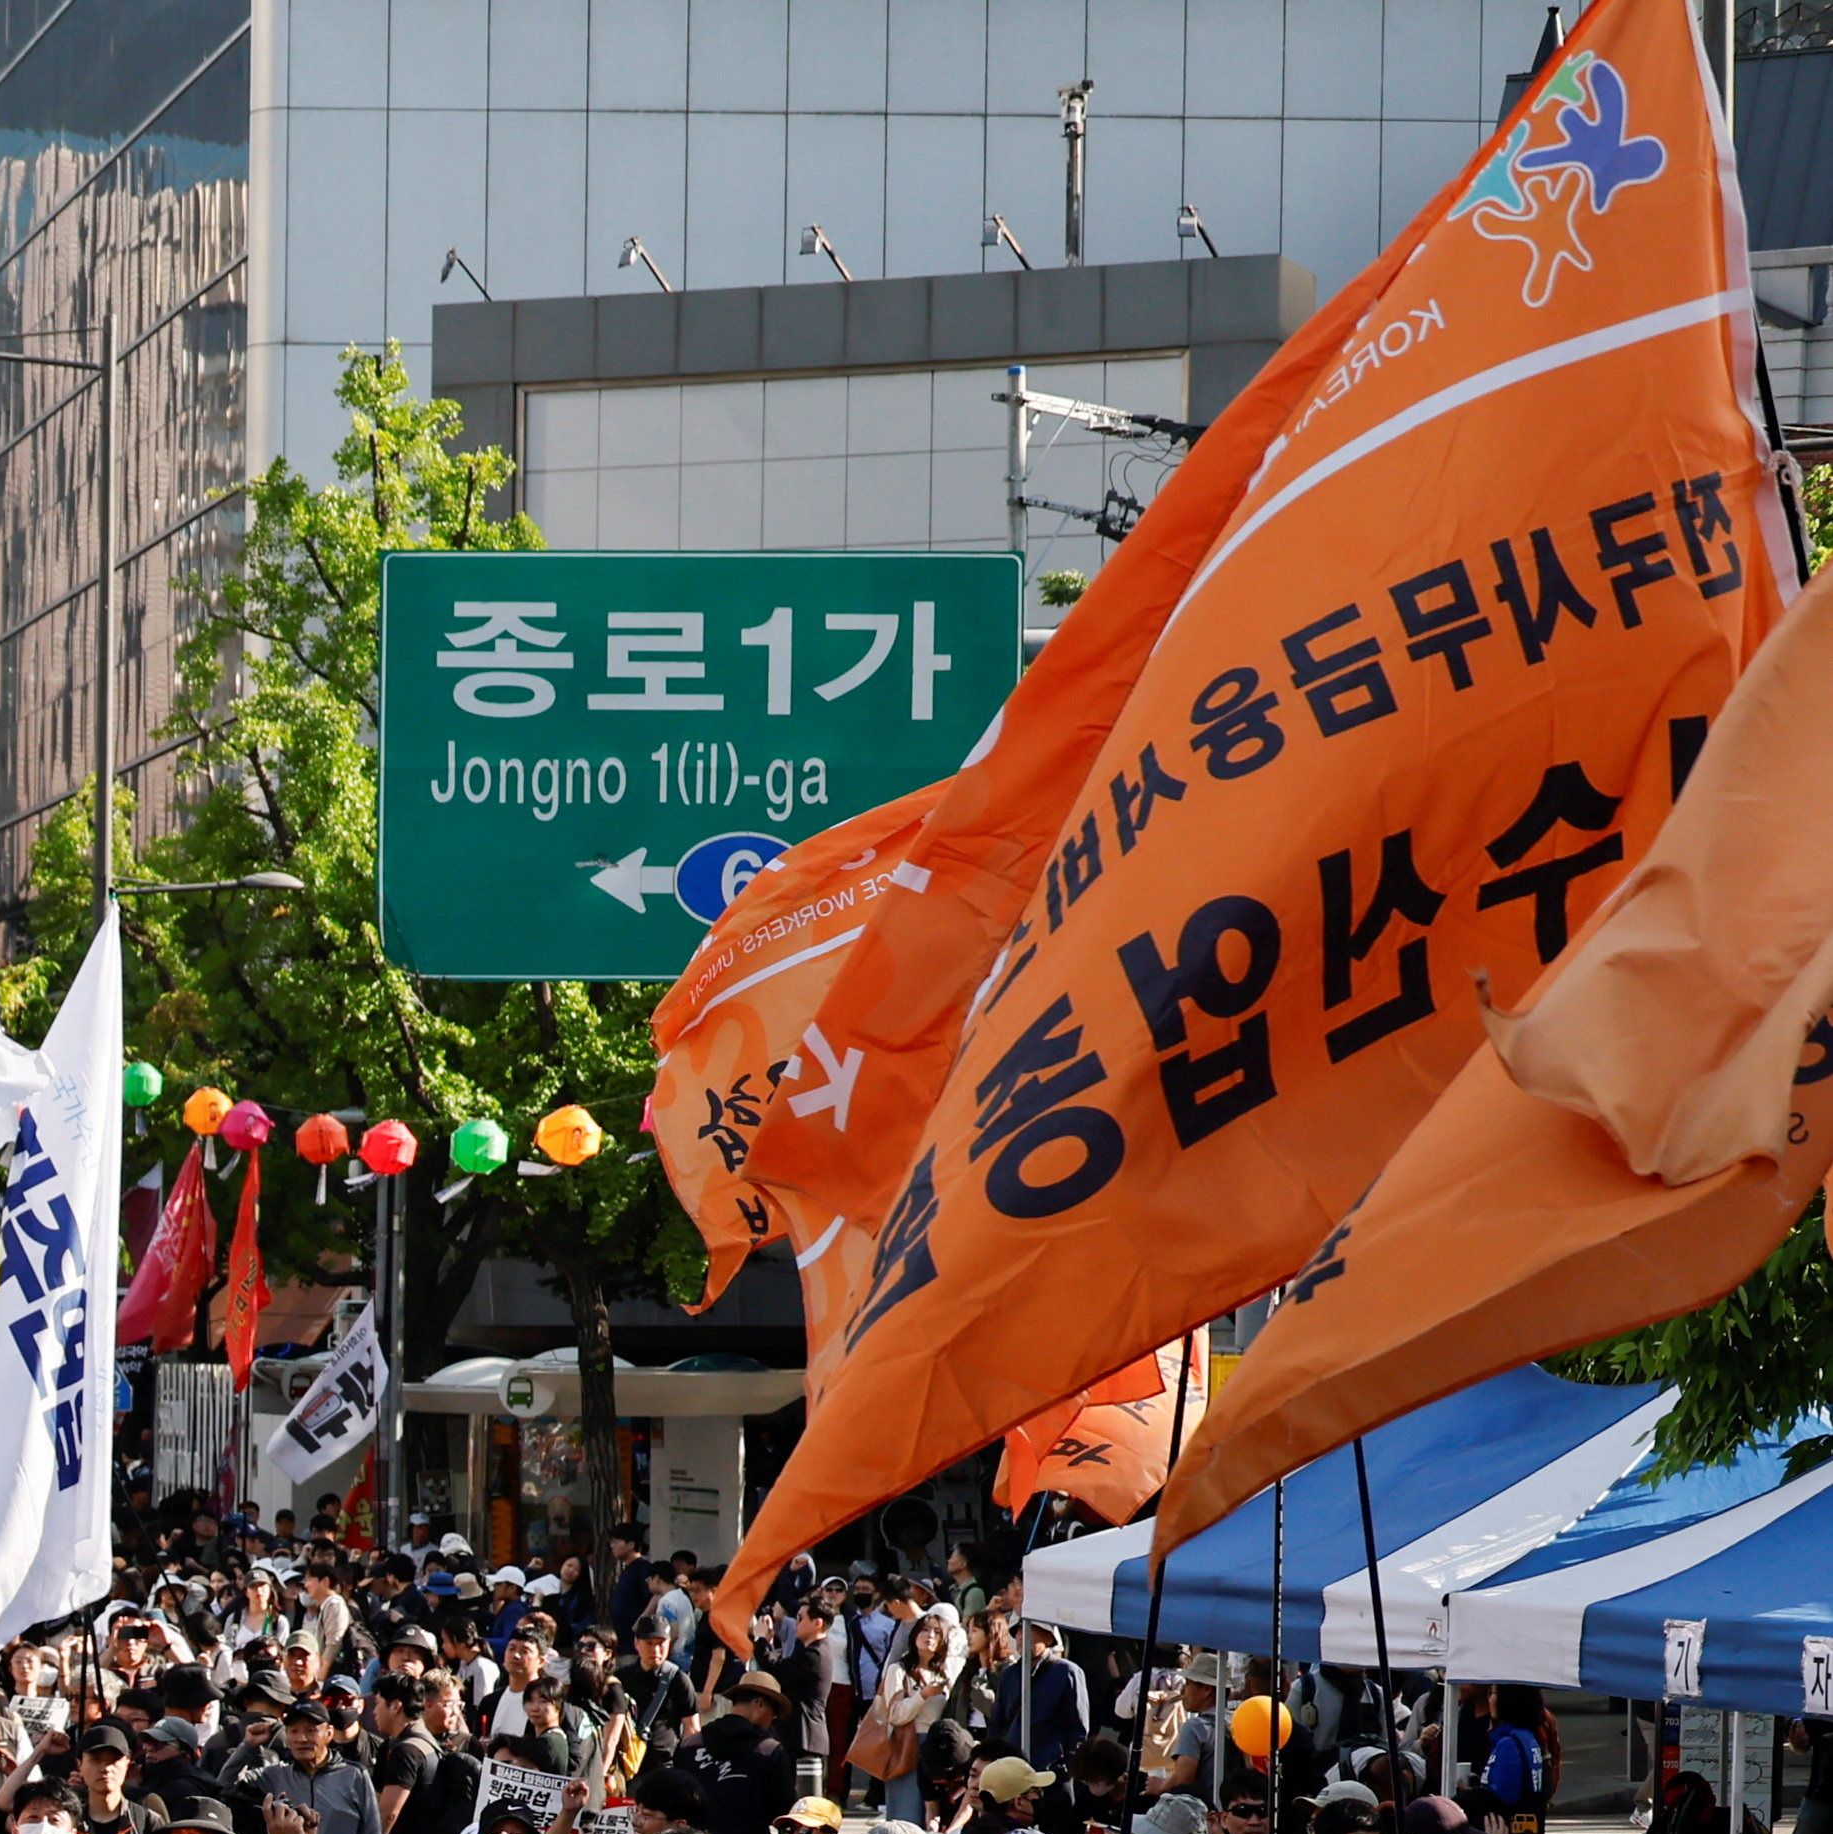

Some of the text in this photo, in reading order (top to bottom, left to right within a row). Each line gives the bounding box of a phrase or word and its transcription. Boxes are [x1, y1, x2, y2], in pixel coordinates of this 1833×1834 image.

[436, 600, 952, 721] 종로1가
[431, 741, 829, 822] Jongno 1(il)-ga
[720, 849, 764, 906] 6
[1674, 1637, 1692, 1691] 기
